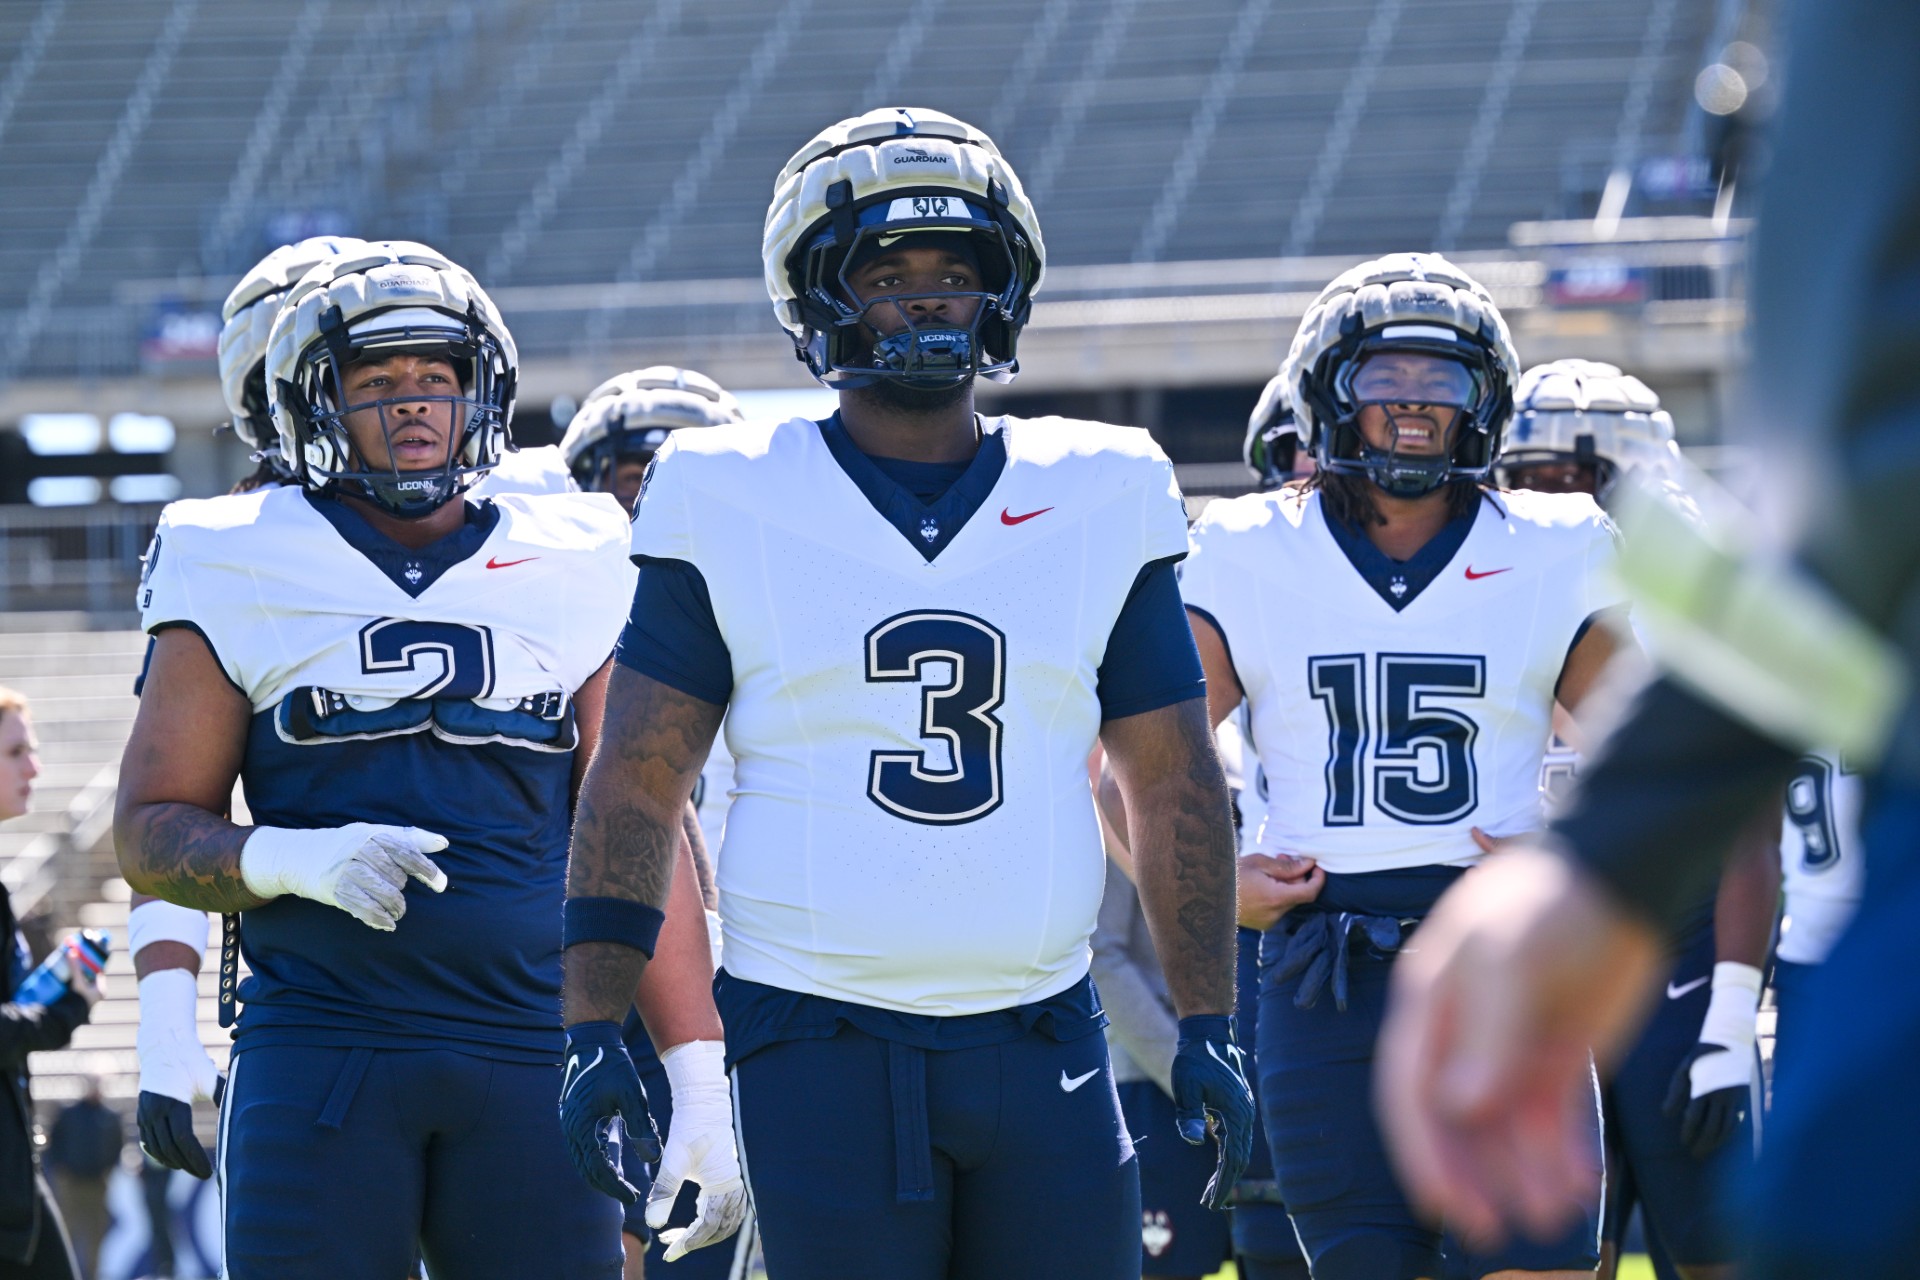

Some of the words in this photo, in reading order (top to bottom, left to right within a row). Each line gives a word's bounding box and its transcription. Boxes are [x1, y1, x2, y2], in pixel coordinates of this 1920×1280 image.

[894, 155, 947, 164] GUARDIAN
[918, 334, 956, 343] UCONN
[467, 408, 485, 432] HUS
[397, 480, 433, 491] UCONN
[864, 608, 1007, 827] 3
[1308, 652, 1486, 827] 15
